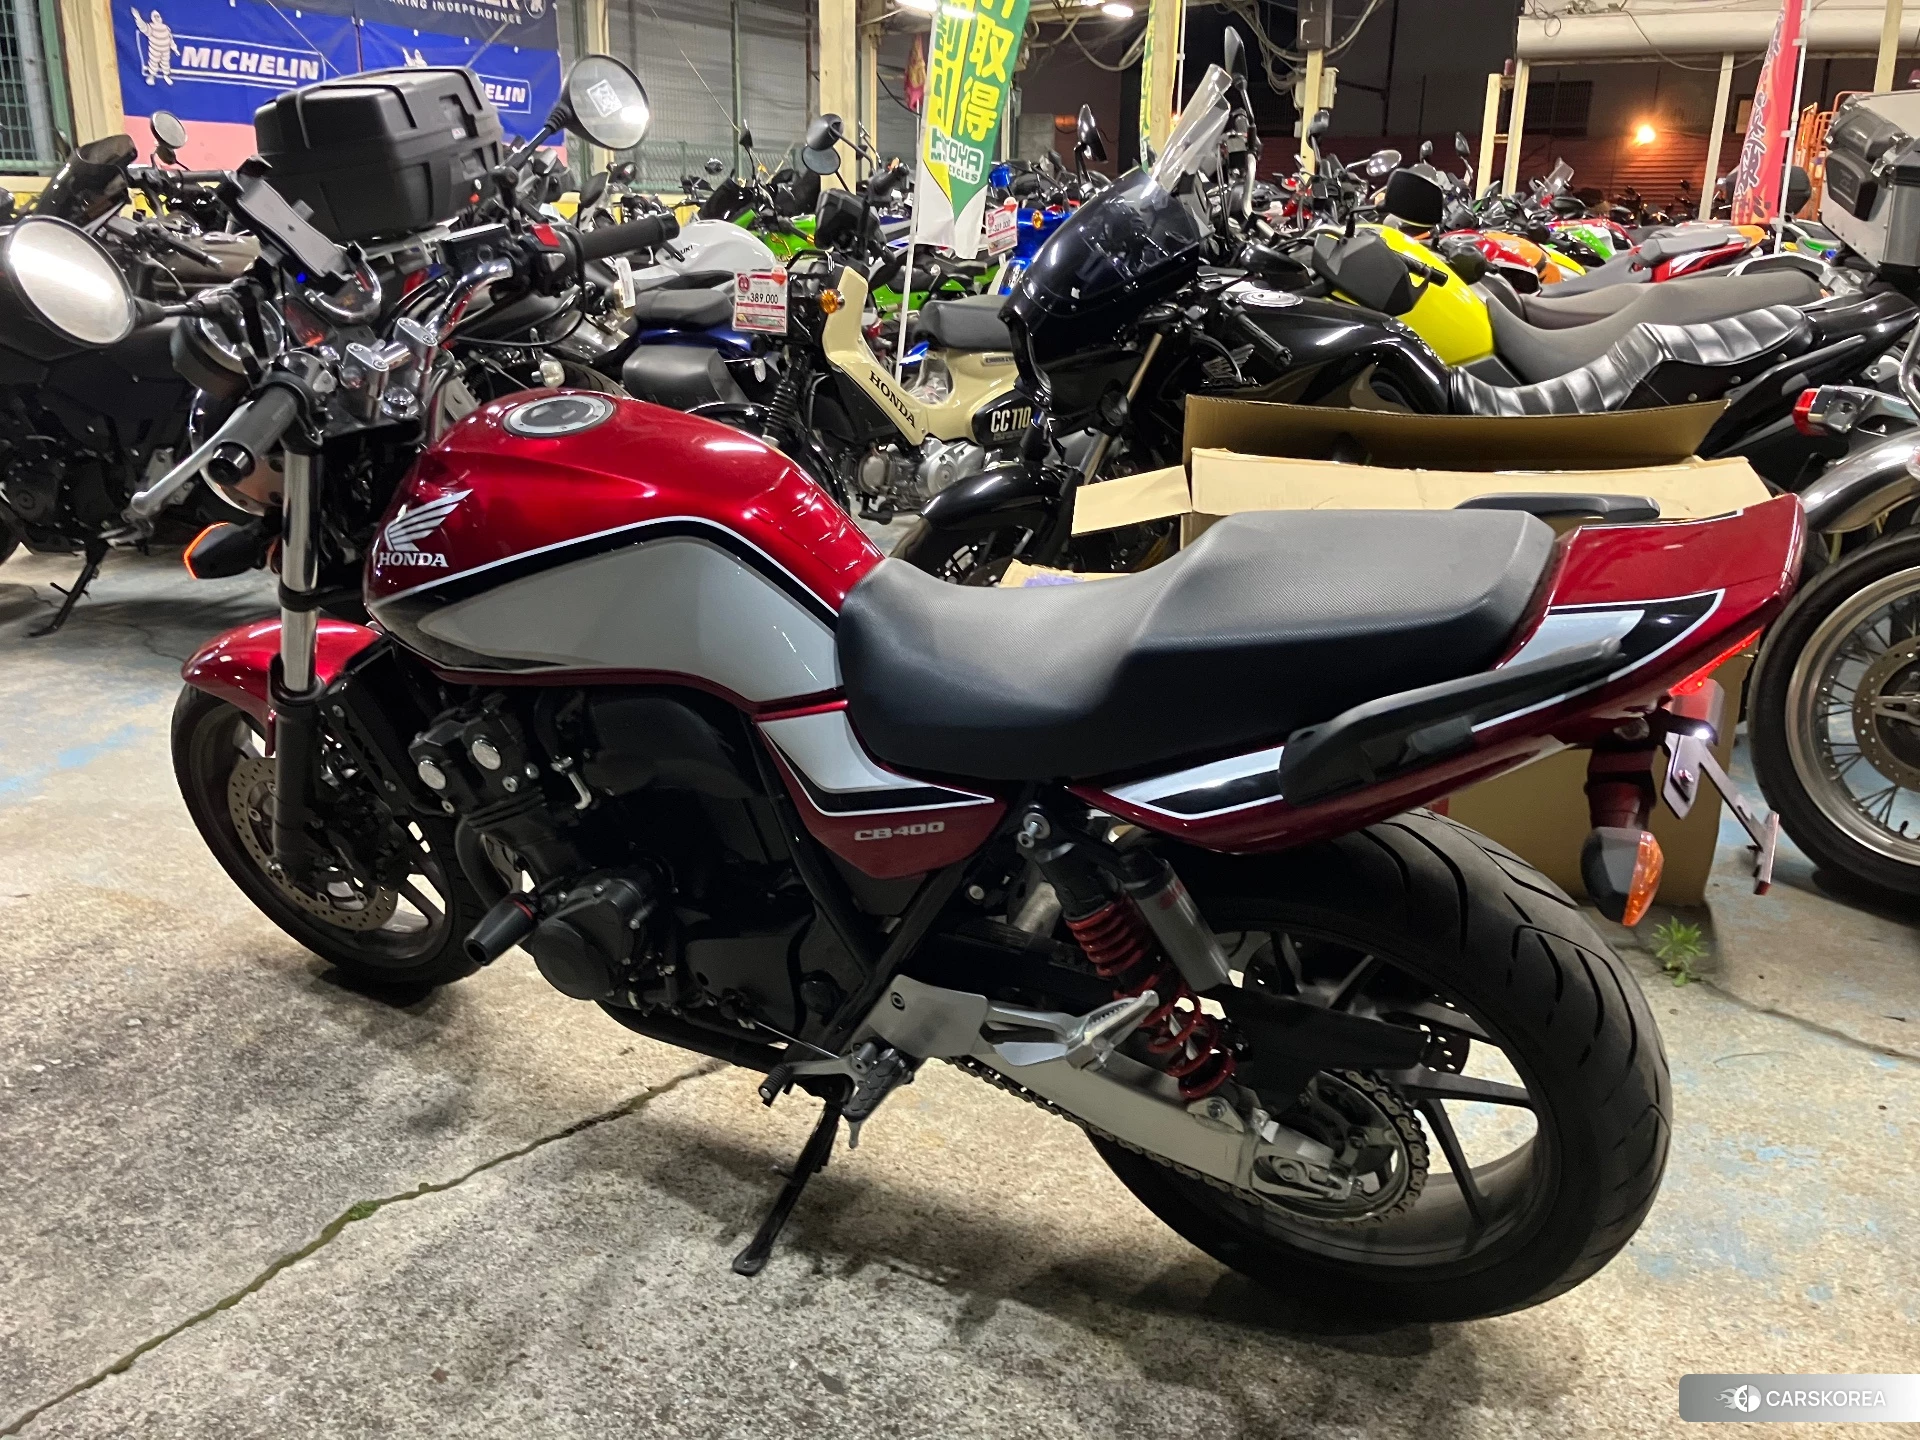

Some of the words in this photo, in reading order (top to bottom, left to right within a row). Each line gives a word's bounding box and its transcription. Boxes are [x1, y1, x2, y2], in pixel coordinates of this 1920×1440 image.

[432, 1, 523, 25] INDEPENDENCE
[181, 45, 320, 80] MICHELIN
[482, 81, 526, 104] ELIN
[868, 370, 916, 429] HONDA
[990, 406, 1032, 433] CC110
[379, 551, 449, 568] HONDA
